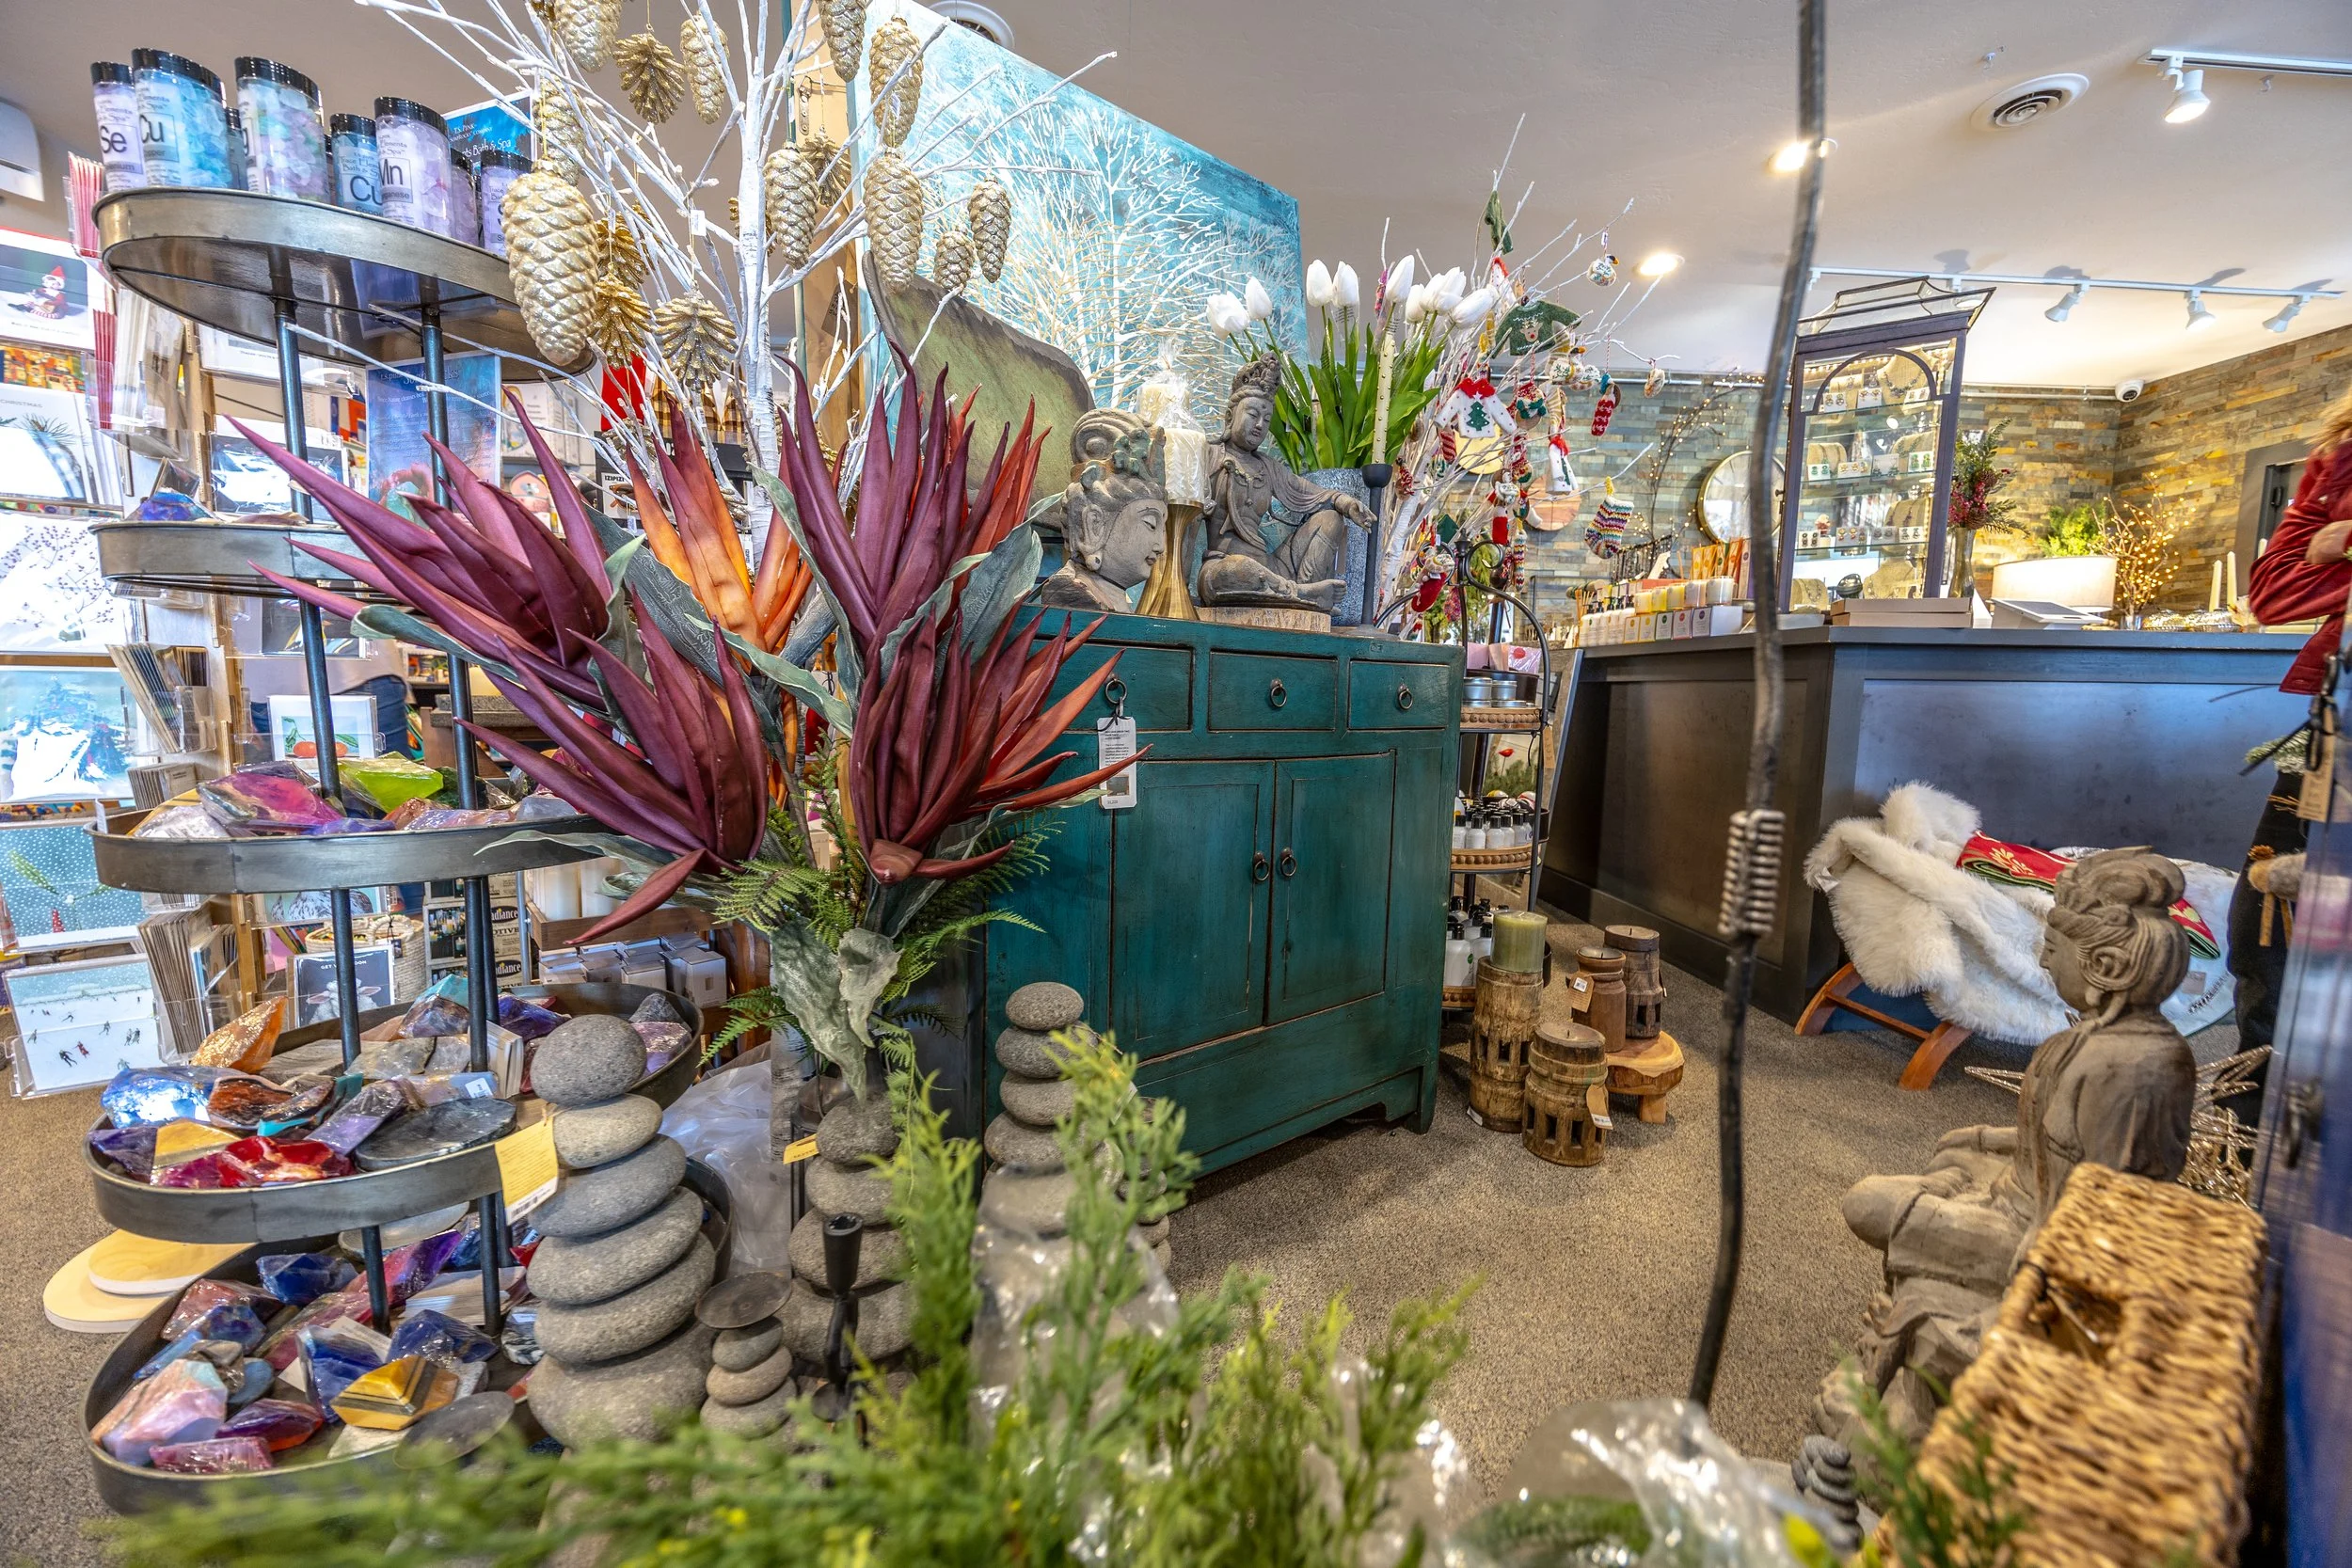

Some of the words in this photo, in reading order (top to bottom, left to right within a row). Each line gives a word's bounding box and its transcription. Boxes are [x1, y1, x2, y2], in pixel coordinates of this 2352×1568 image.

[101, 125, 127, 154] Se
[473, 138, 488, 156] Bath
[497, 138, 512, 152] Spa
[491, 908, 518, 921] adiance
[493, 927, 518, 936] OTIVE
